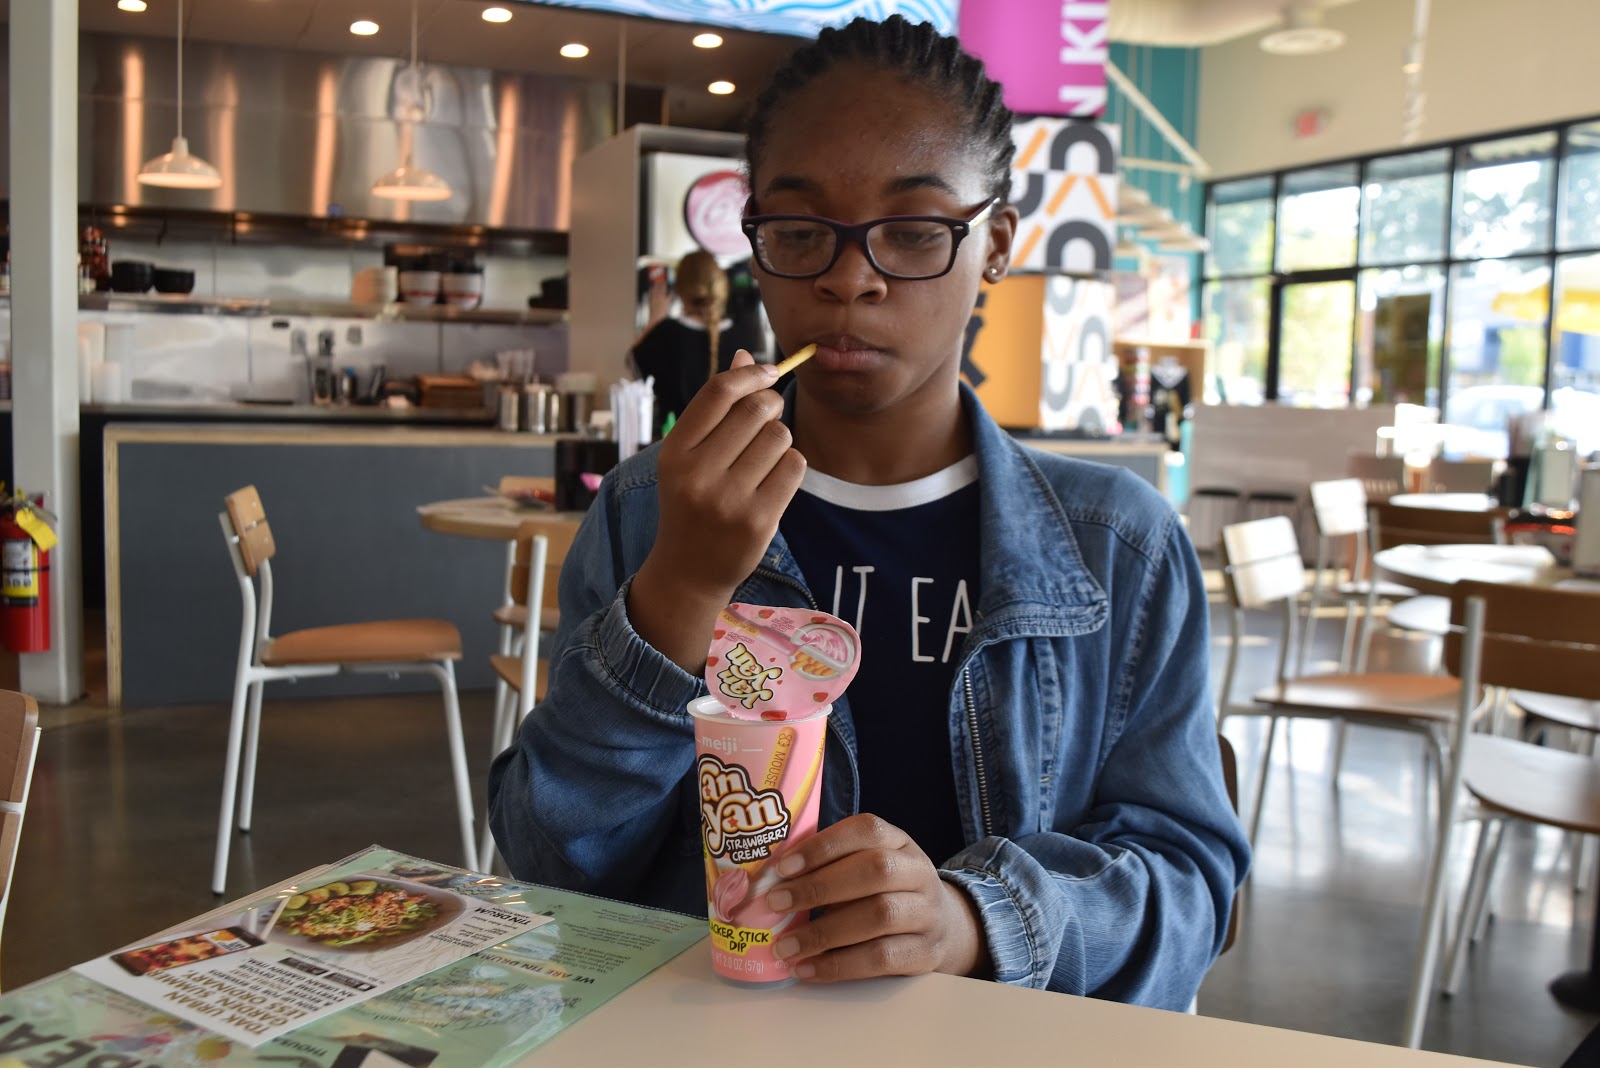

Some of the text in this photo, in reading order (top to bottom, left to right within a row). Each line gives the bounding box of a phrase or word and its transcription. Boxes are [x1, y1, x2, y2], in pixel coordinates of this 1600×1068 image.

[1060, 0, 1108, 64] KI
[912, 577, 974, 663] EA
[702, 736, 738, 755] meiji
[765, 751, 786, 787] MOUSE
[726, 824, 788, 850] STRAWBERRY
[474, 907, 530, 924] TIN DRUM
[710, 922, 769, 942] ACKER STICK
[729, 941, 747, 952] DIP
[470, 952, 520, 965] DRUMM
[734, 957, 742, 970] OZ
[745, 960, 764, 973] (57g)
[238, 964, 275, 978] DEVOUR
[268, 966, 305, 980] GARDEN
[521, 963, 542, 971] TIN
[547, 970, 572, 978] ARE
[142, 971, 213, 997] SUMMER
[274, 976, 294, 985] YOU
[305, 979, 338, 991] URBAN
[573, 975, 594, 983] WE
[165, 991, 223, 1016] URBAN
[286, 989, 322, 1003] RECEIVE
[266, 1002, 305, 1018] LESS
[226, 1014, 268, 1034] TDAK
